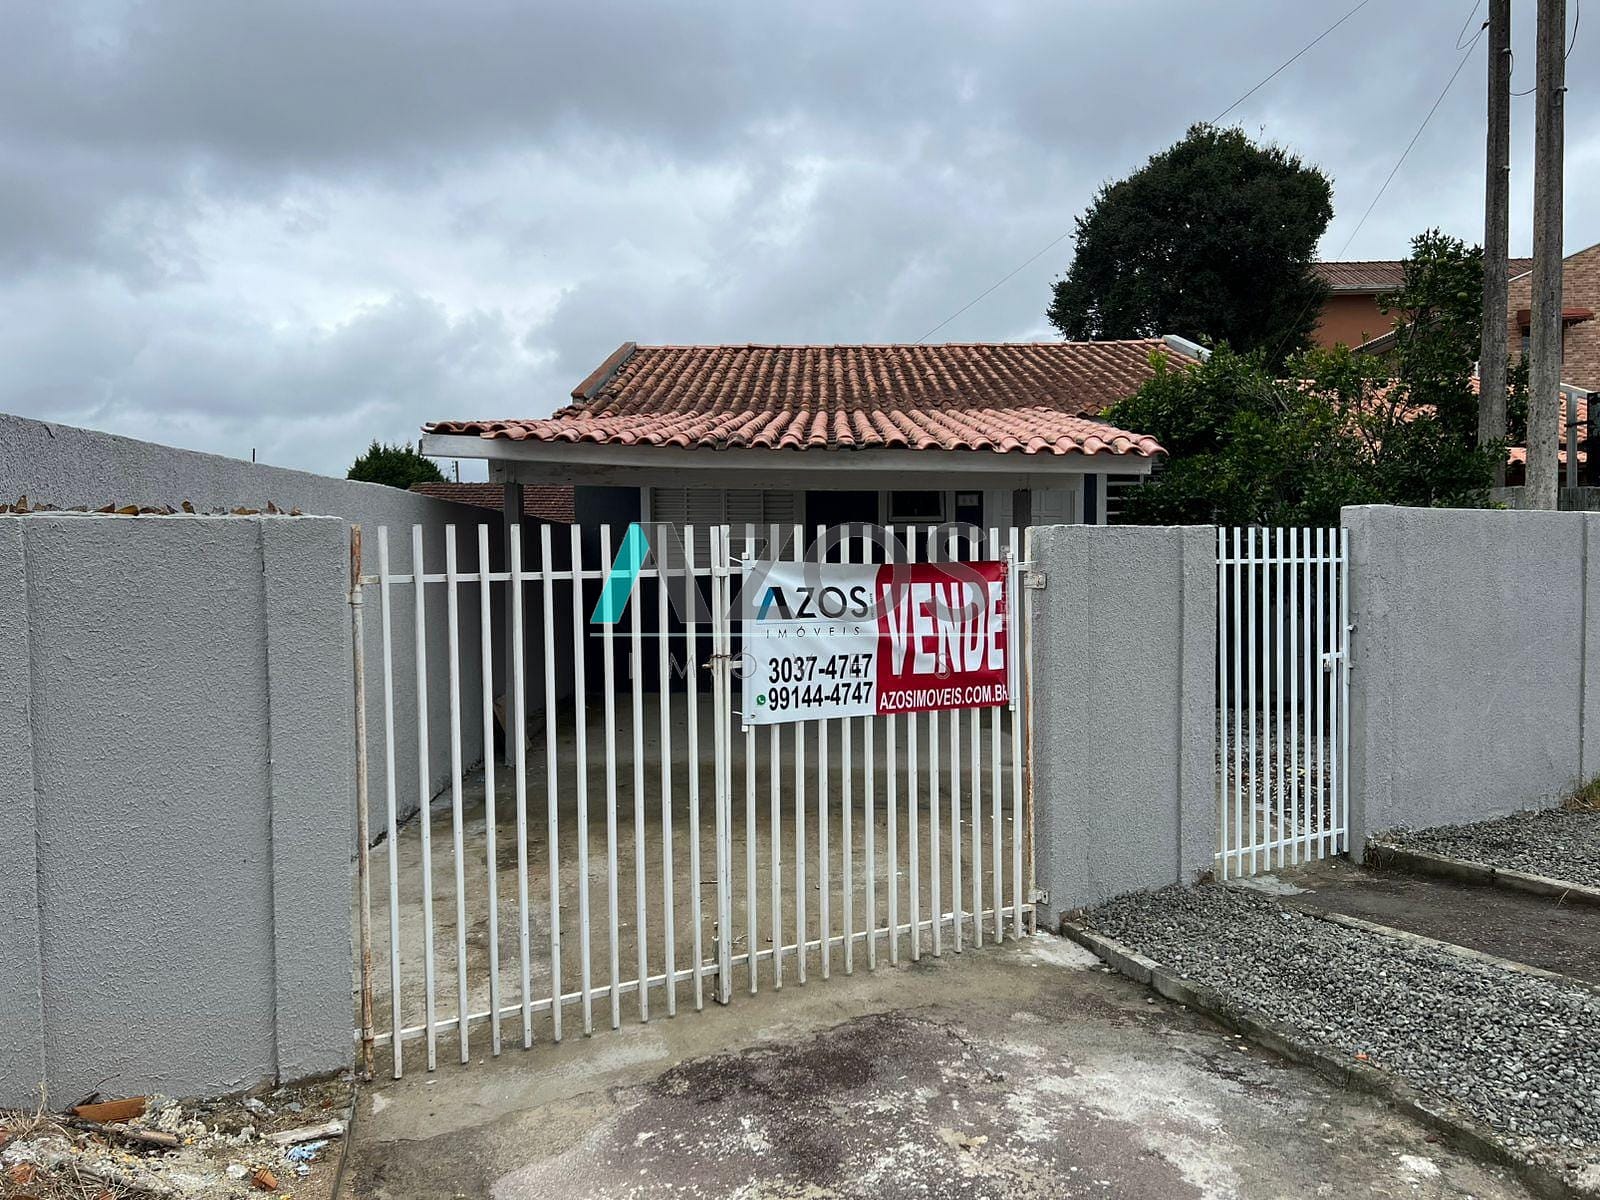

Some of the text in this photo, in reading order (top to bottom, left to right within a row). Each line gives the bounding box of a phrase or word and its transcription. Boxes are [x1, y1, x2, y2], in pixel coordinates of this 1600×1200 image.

[757, 586, 869, 620] AZOS
[767, 626, 860, 638] IMÓVEIS
[882, 582, 1004, 675] VENDE
[769, 654, 872, 683] 3037-4747
[769, 682, 873, 710] 99144-4747
